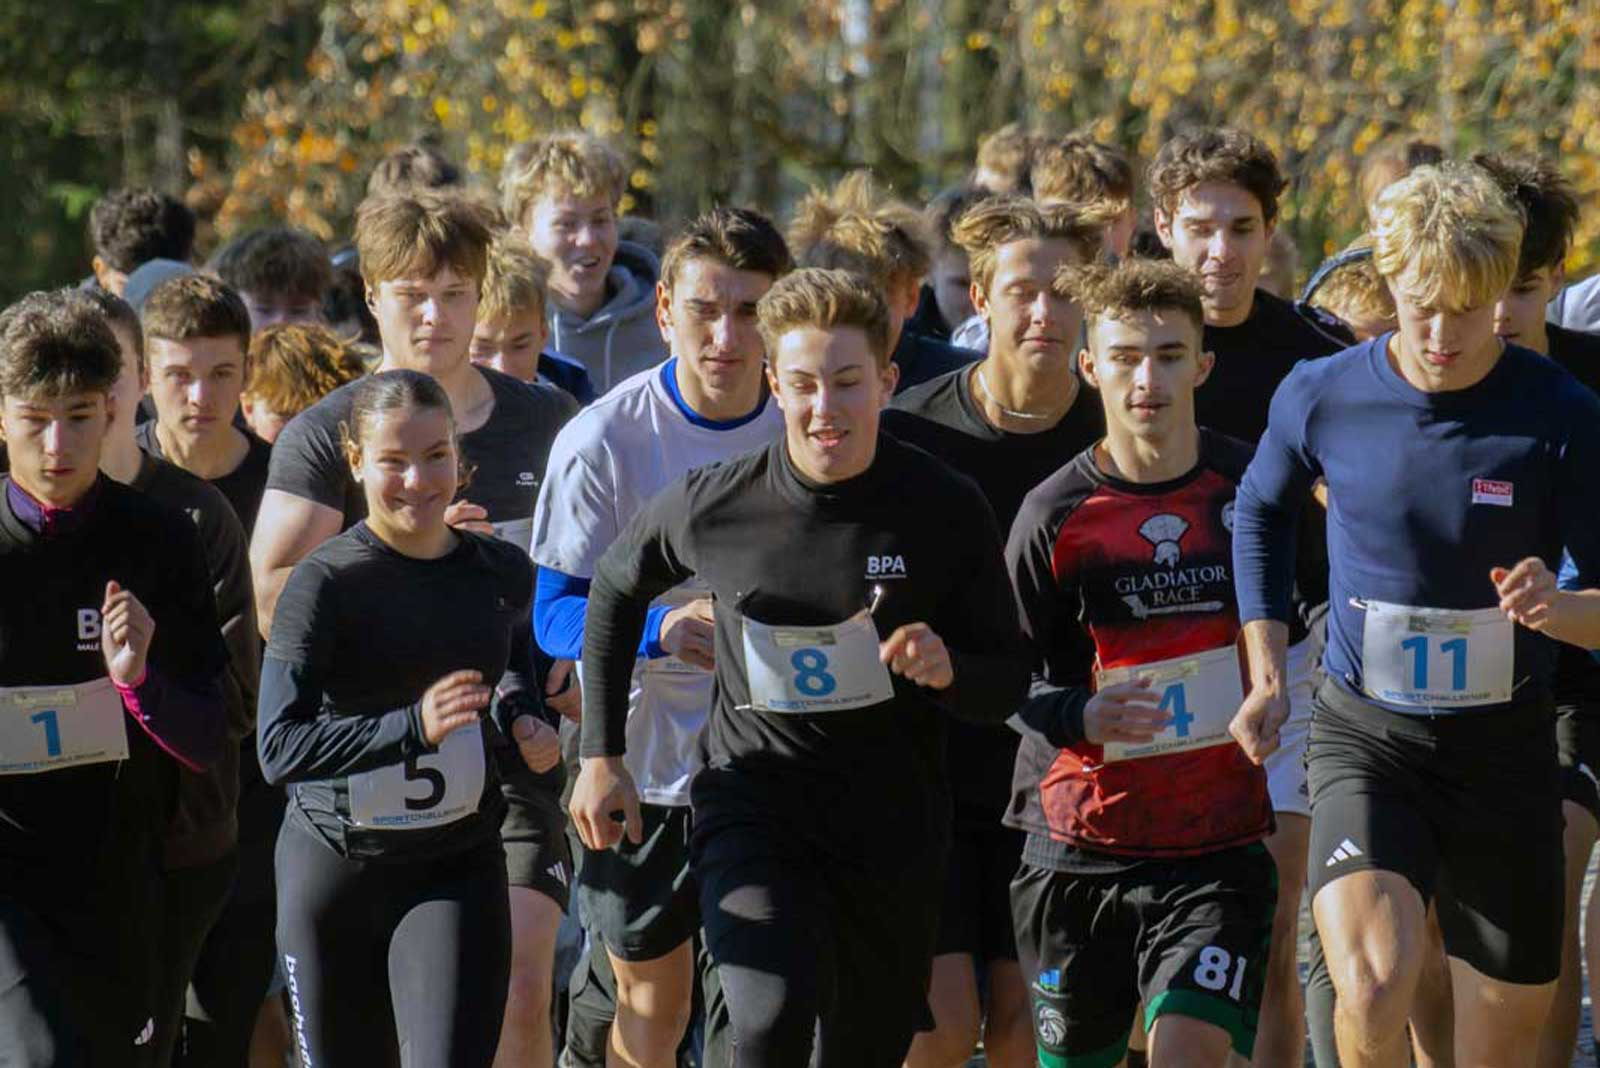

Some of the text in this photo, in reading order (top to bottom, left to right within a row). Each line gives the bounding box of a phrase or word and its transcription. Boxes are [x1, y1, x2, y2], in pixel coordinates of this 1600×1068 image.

[867, 555, 906, 574] BPA
[1115, 566, 1228, 594] GLADIATOR
[1153, 586, 1200, 606] RACE
[791, 648, 836, 696] 8
[1401, 636, 1468, 690] 11
[30, 710, 61, 757] 1
[1156, 682, 1194, 737] 4
[404, 750, 446, 810] 5
[1194, 945, 1247, 1001] 81
